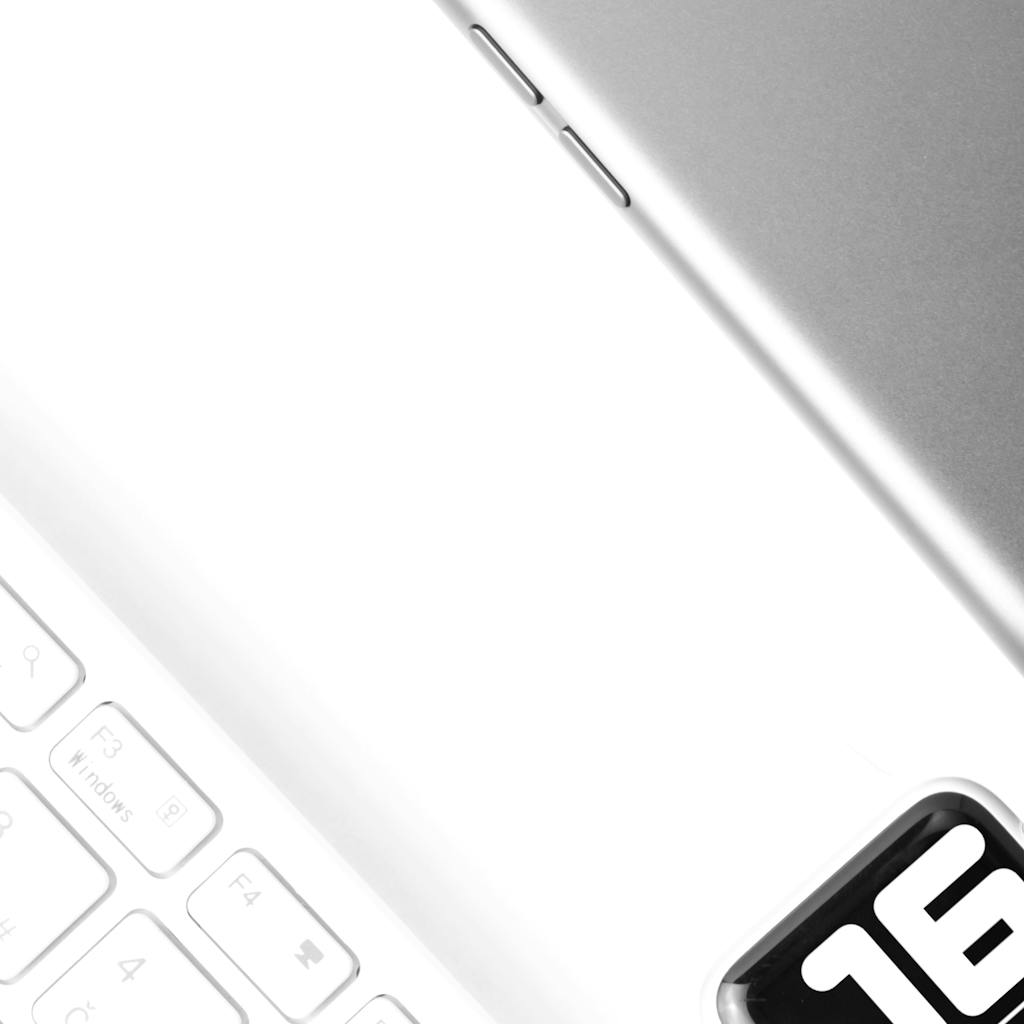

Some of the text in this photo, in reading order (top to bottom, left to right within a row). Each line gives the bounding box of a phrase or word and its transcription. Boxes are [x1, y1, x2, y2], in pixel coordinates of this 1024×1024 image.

[89, 724, 124, 759] F3
[67, 748, 134, 823] Windows
[227, 872, 263, 908] F4
[117, 957, 147, 983] 4
